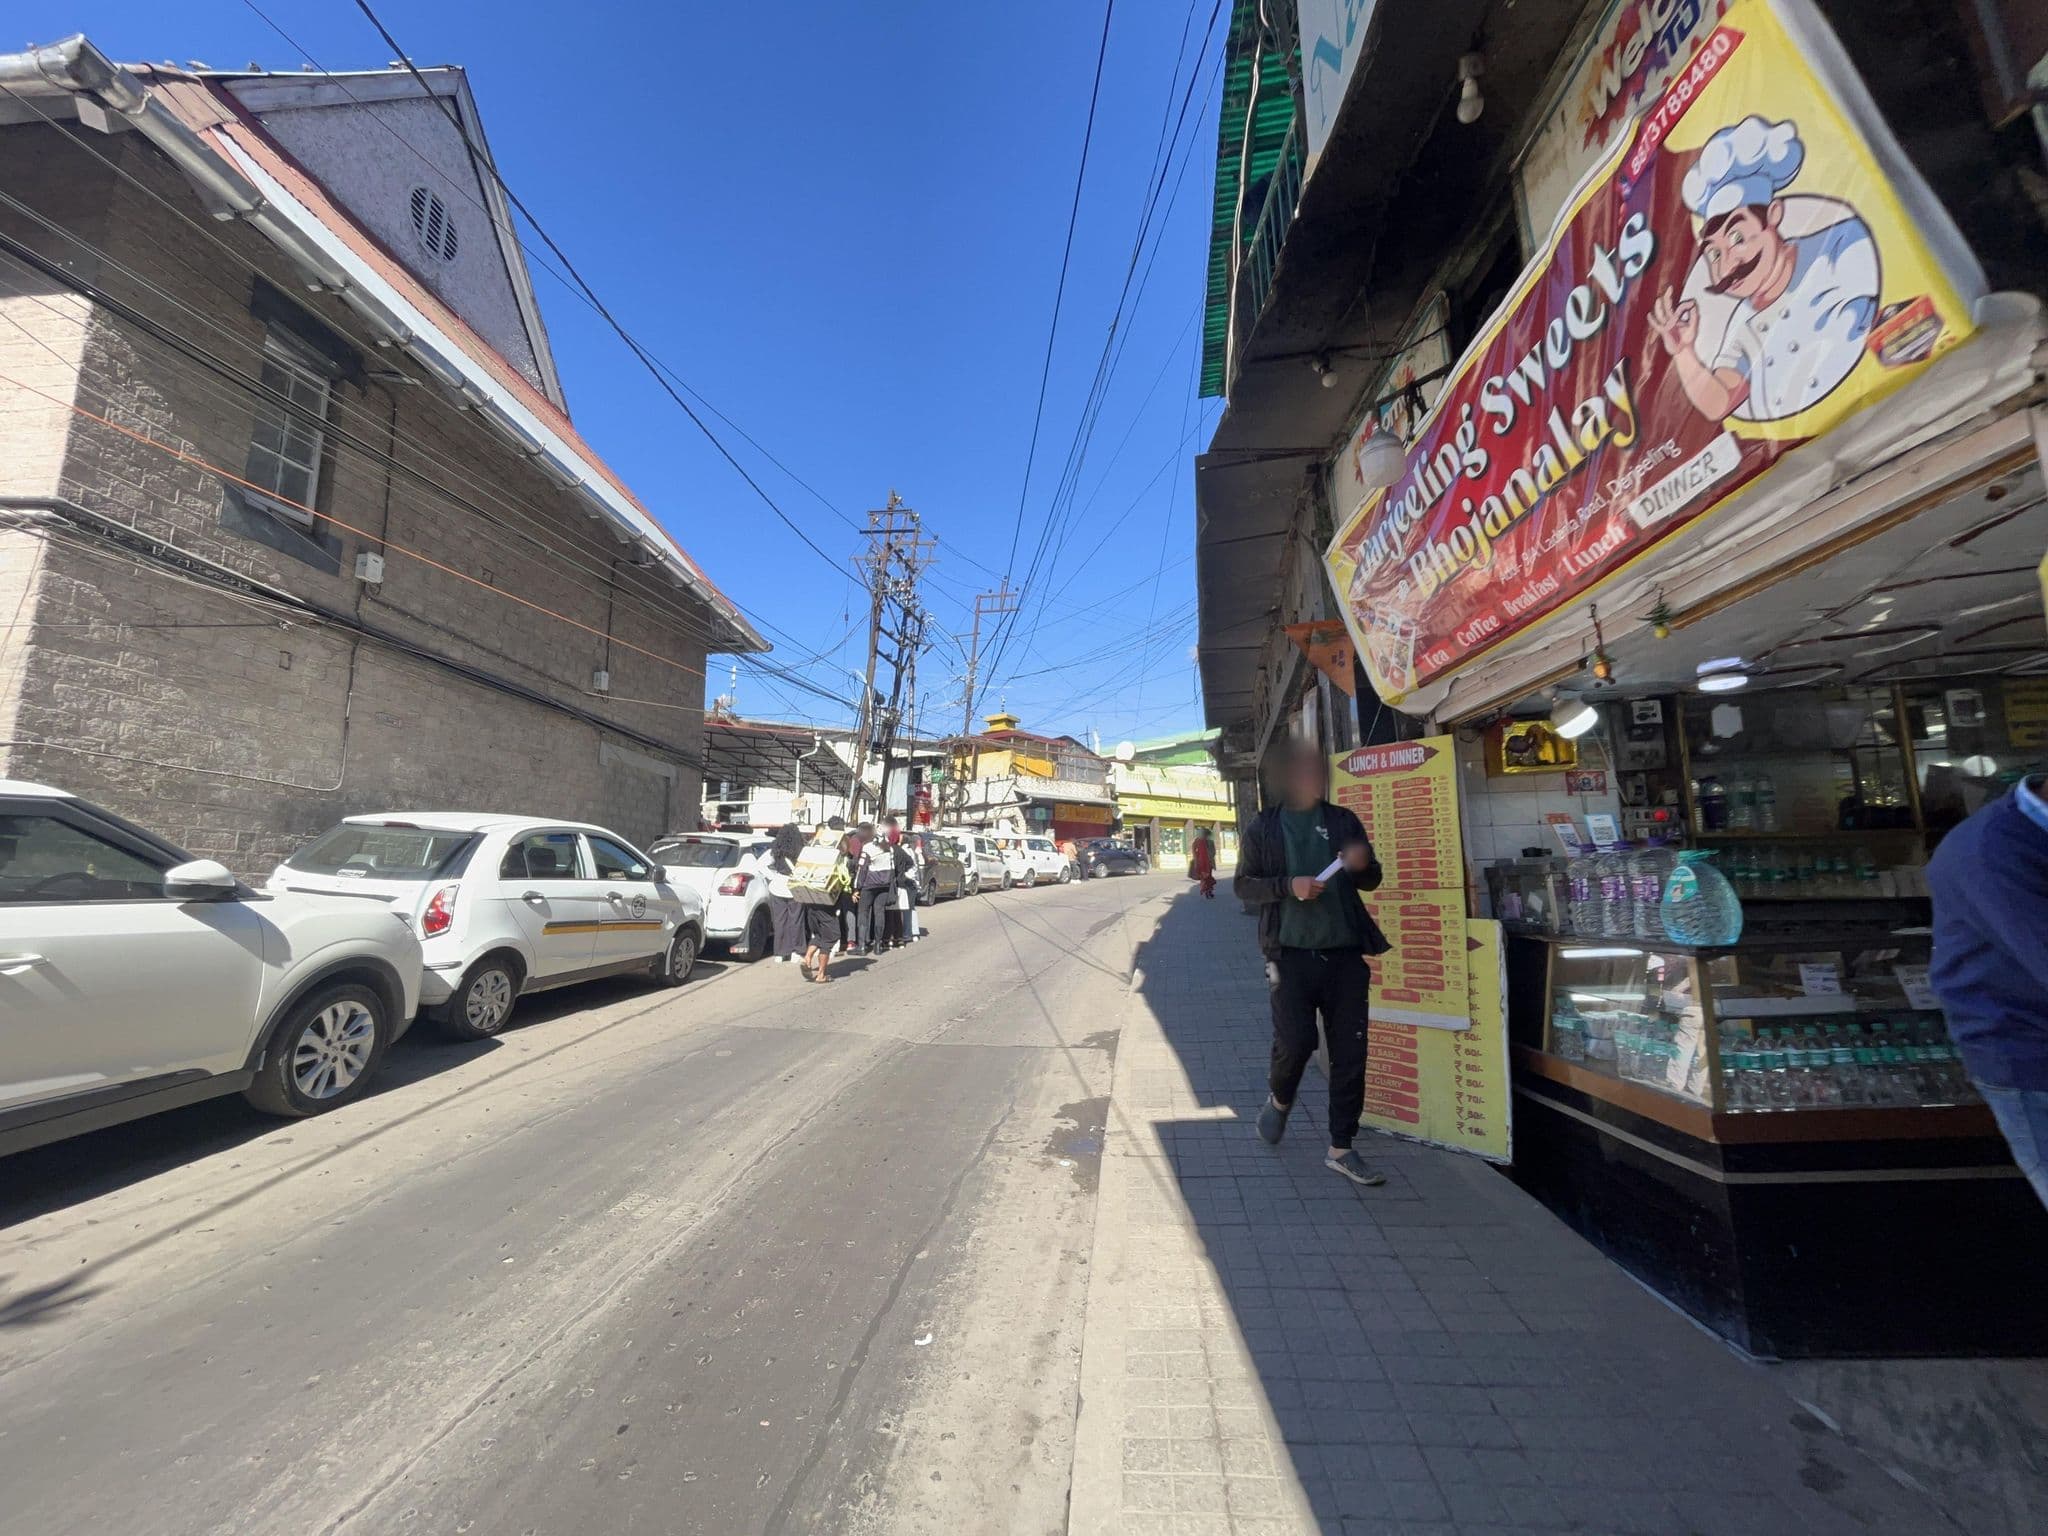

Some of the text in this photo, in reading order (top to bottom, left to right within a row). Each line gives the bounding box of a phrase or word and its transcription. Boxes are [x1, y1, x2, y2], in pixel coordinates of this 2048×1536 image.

[1480, 212, 1655, 435] Sweets
[1408, 357, 1636, 599] Bhojanalay
[1423, 450, 1719, 671] Tea Coffee Breakfast Lunch DINNER
[1348, 746, 1425, 772] LUNCH & DINNER
